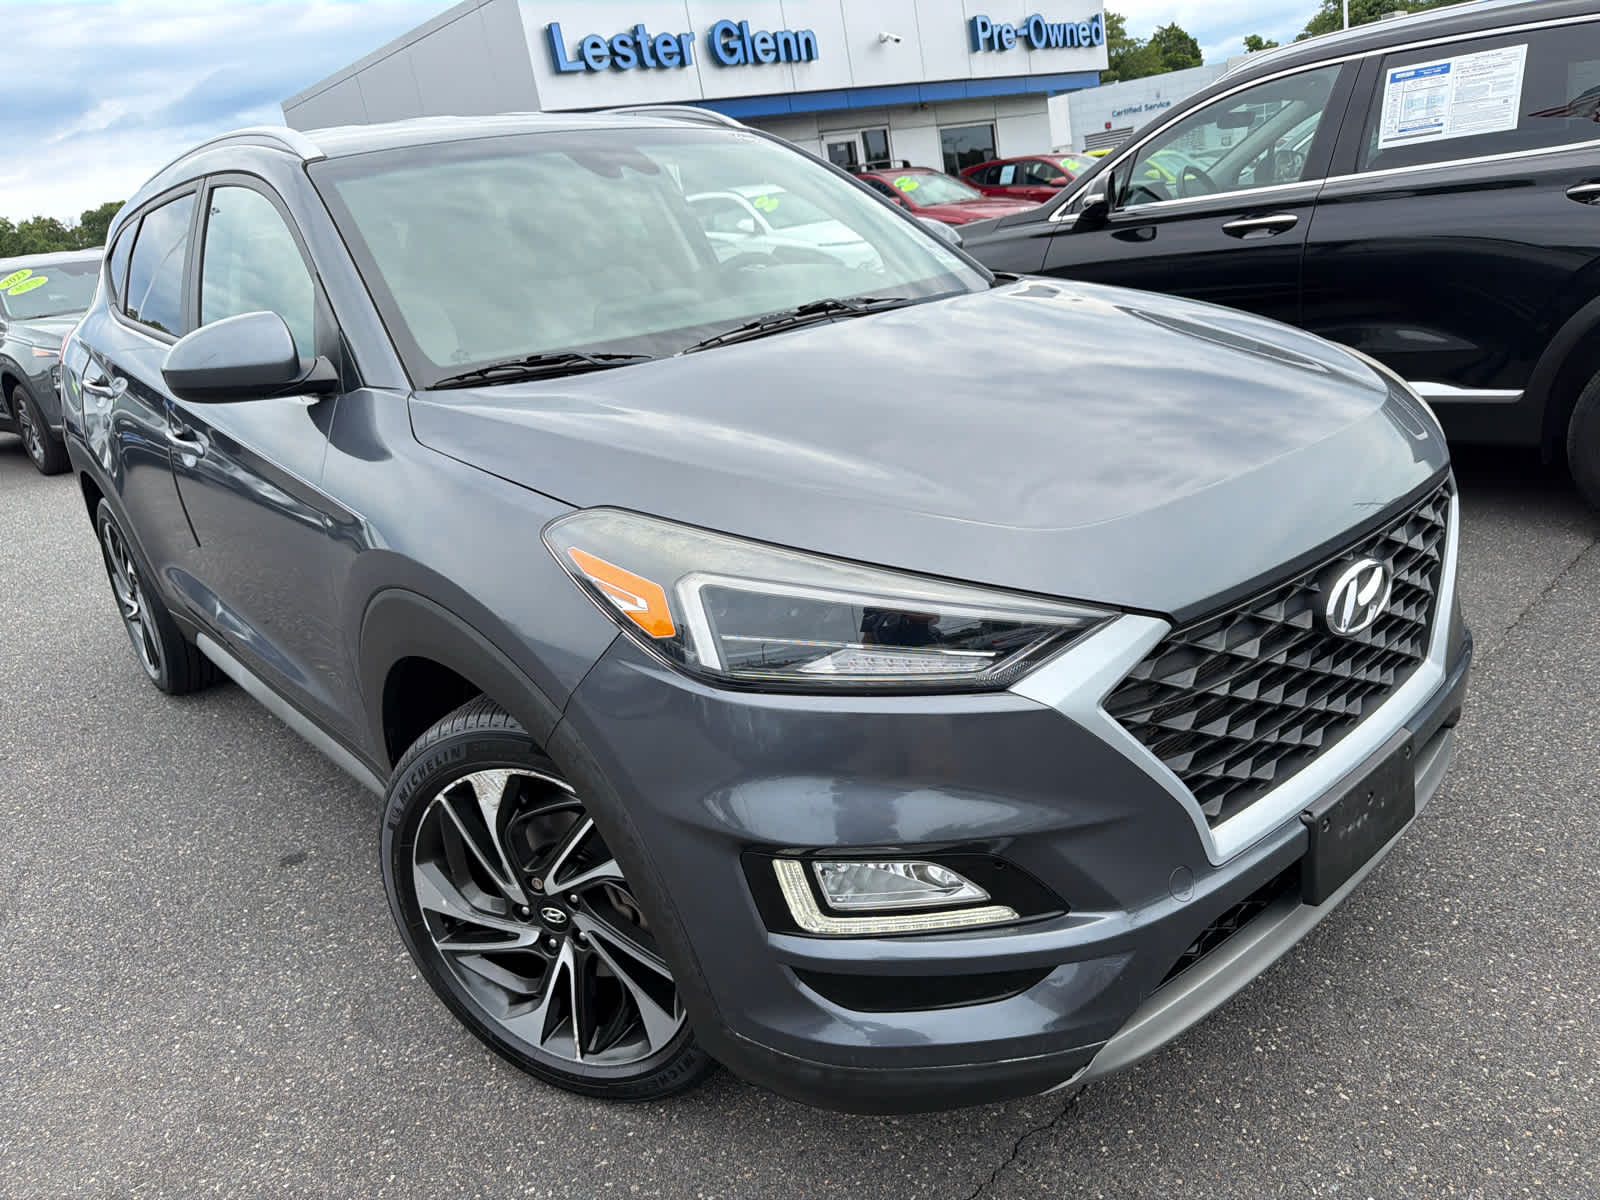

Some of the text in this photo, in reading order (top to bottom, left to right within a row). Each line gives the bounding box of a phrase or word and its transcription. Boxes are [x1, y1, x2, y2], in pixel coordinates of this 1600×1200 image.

[547, 18, 819, 73] Lester Glenn
[970, 12, 1104, 52] Pre-Owned
[1111, 100, 1171, 117] Certified Service
[399, 746, 462, 801] MICHELIN
